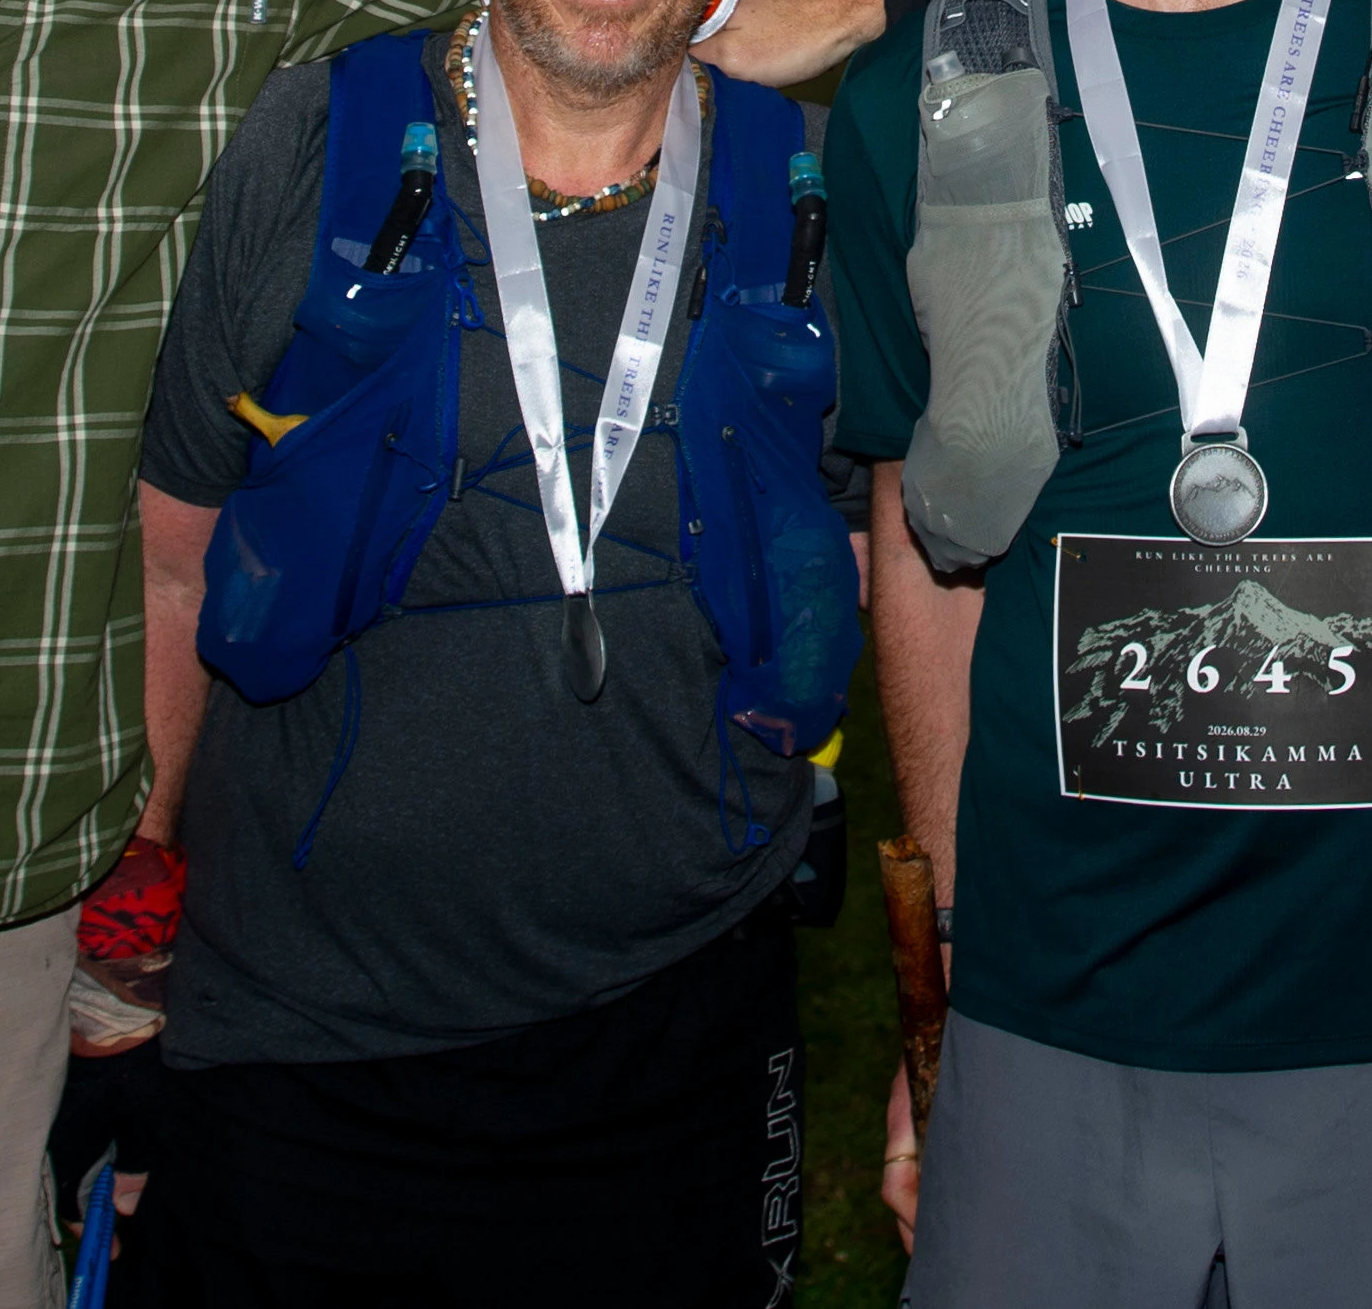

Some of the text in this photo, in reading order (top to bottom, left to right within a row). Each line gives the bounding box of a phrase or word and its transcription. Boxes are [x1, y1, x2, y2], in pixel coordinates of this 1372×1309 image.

[1276, 60, 1297, 100] ARE
[1250, 105, 1287, 217] CHEERING
[656, 212, 676, 255] RUN
[644, 256, 666, 304] LIKE
[616, 356, 642, 419] TREES
[602, 423, 624, 461] ARE
[1135, 550, 1335, 563] RUN LIKE THE TREES ARE
[1194, 563, 1272, 574] CHEERING
[1118, 641, 1357, 696] 2645
[1206, 724, 1267, 738] 2026.08.29
[1112, 739, 1364, 763] TSITSIKAMMA
[1178, 770, 1293, 791] ULTRA
